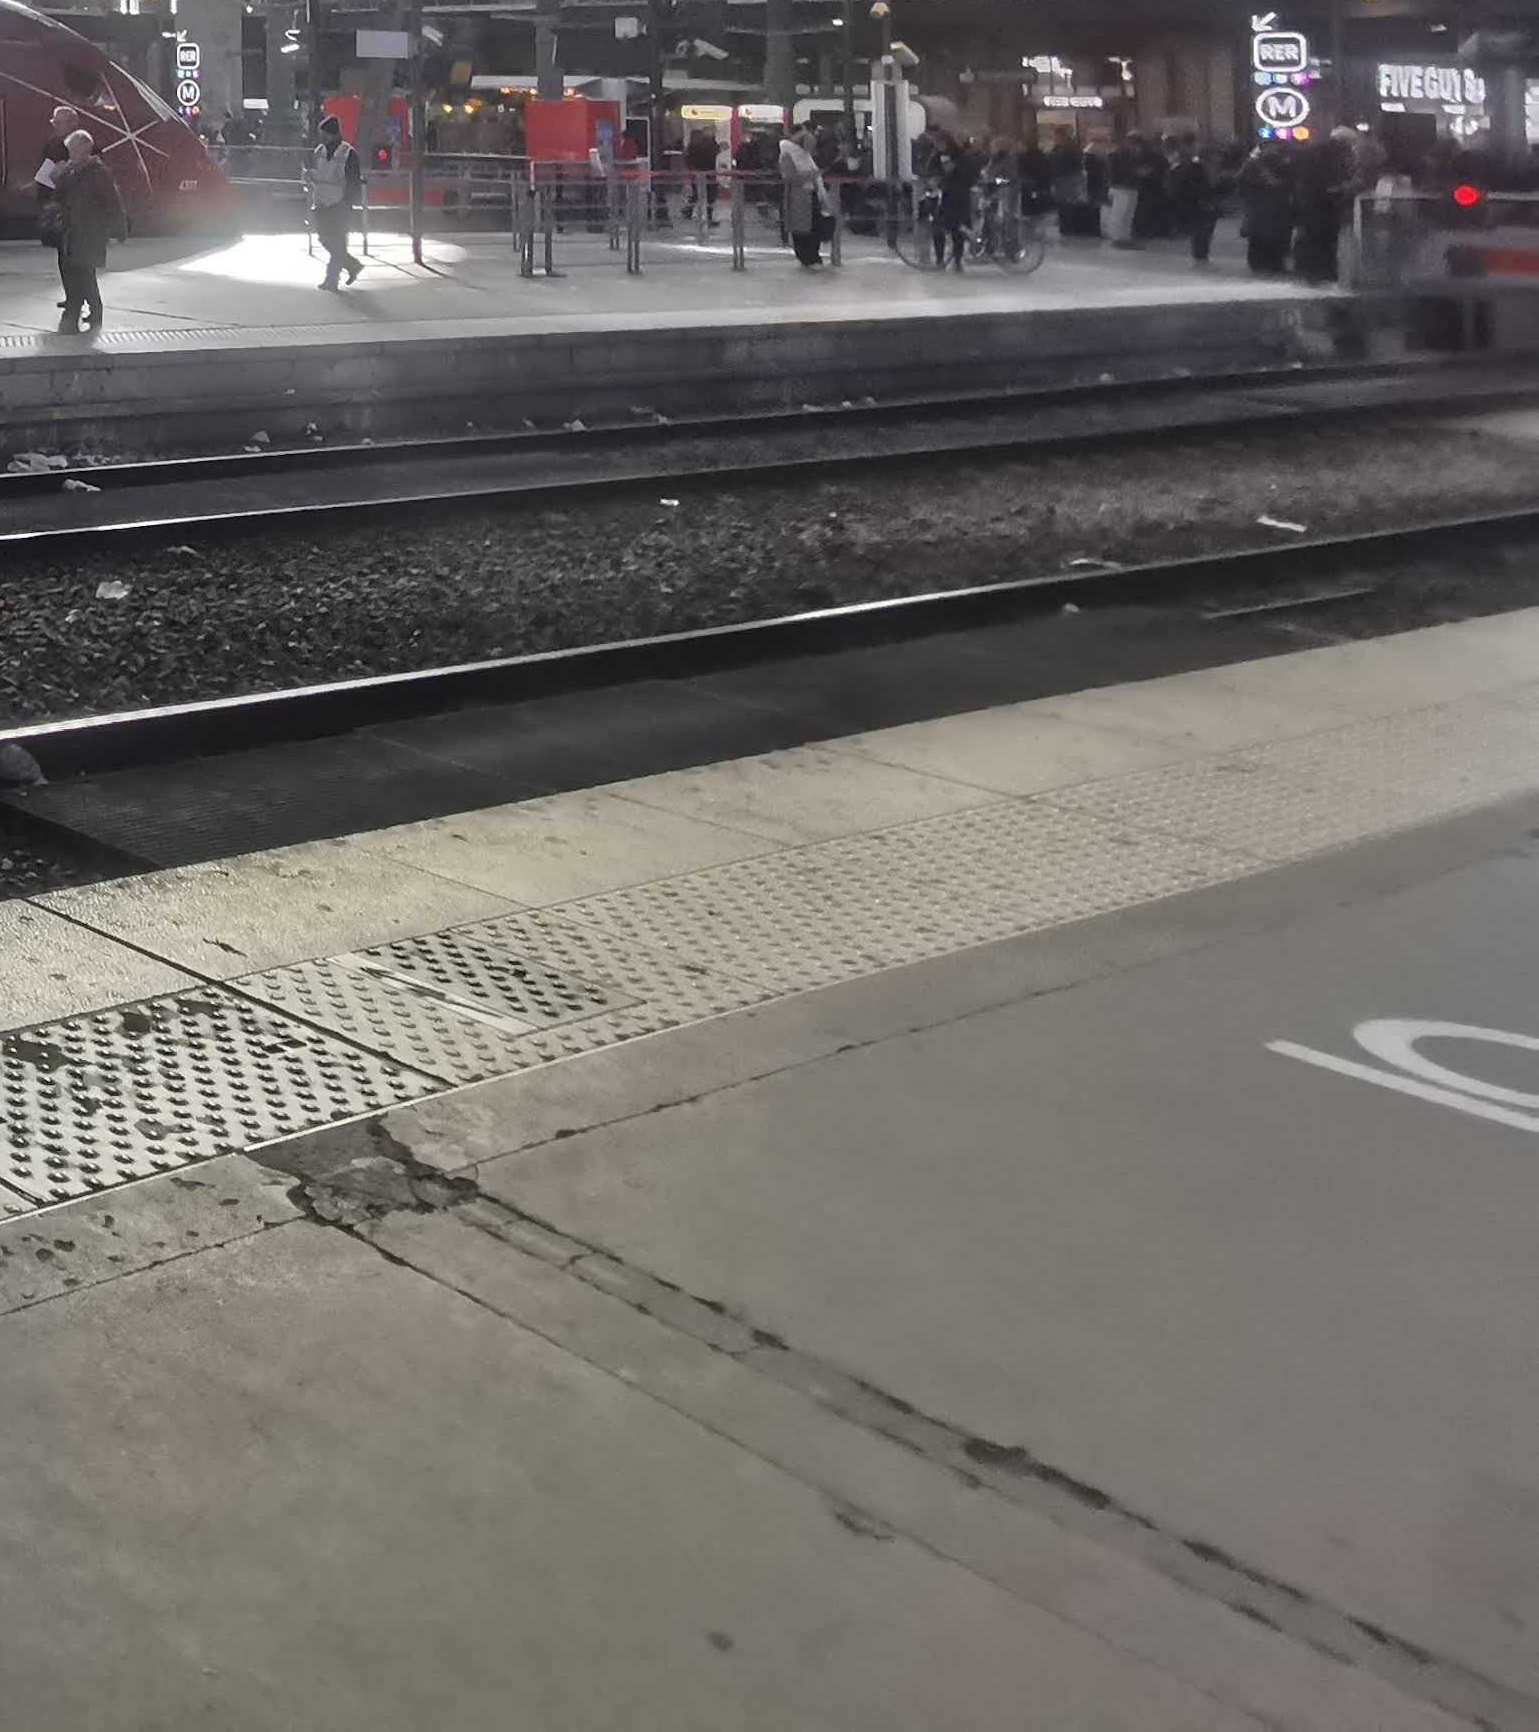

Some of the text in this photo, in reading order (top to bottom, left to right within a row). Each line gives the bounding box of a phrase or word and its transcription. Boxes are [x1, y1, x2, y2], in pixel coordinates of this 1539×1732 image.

[180, 50, 196, 62] RER
[1261, 43, 1300, 61] RER
[1378, 64, 1424, 98] FIVE
[1268, 96, 1297, 118] M
